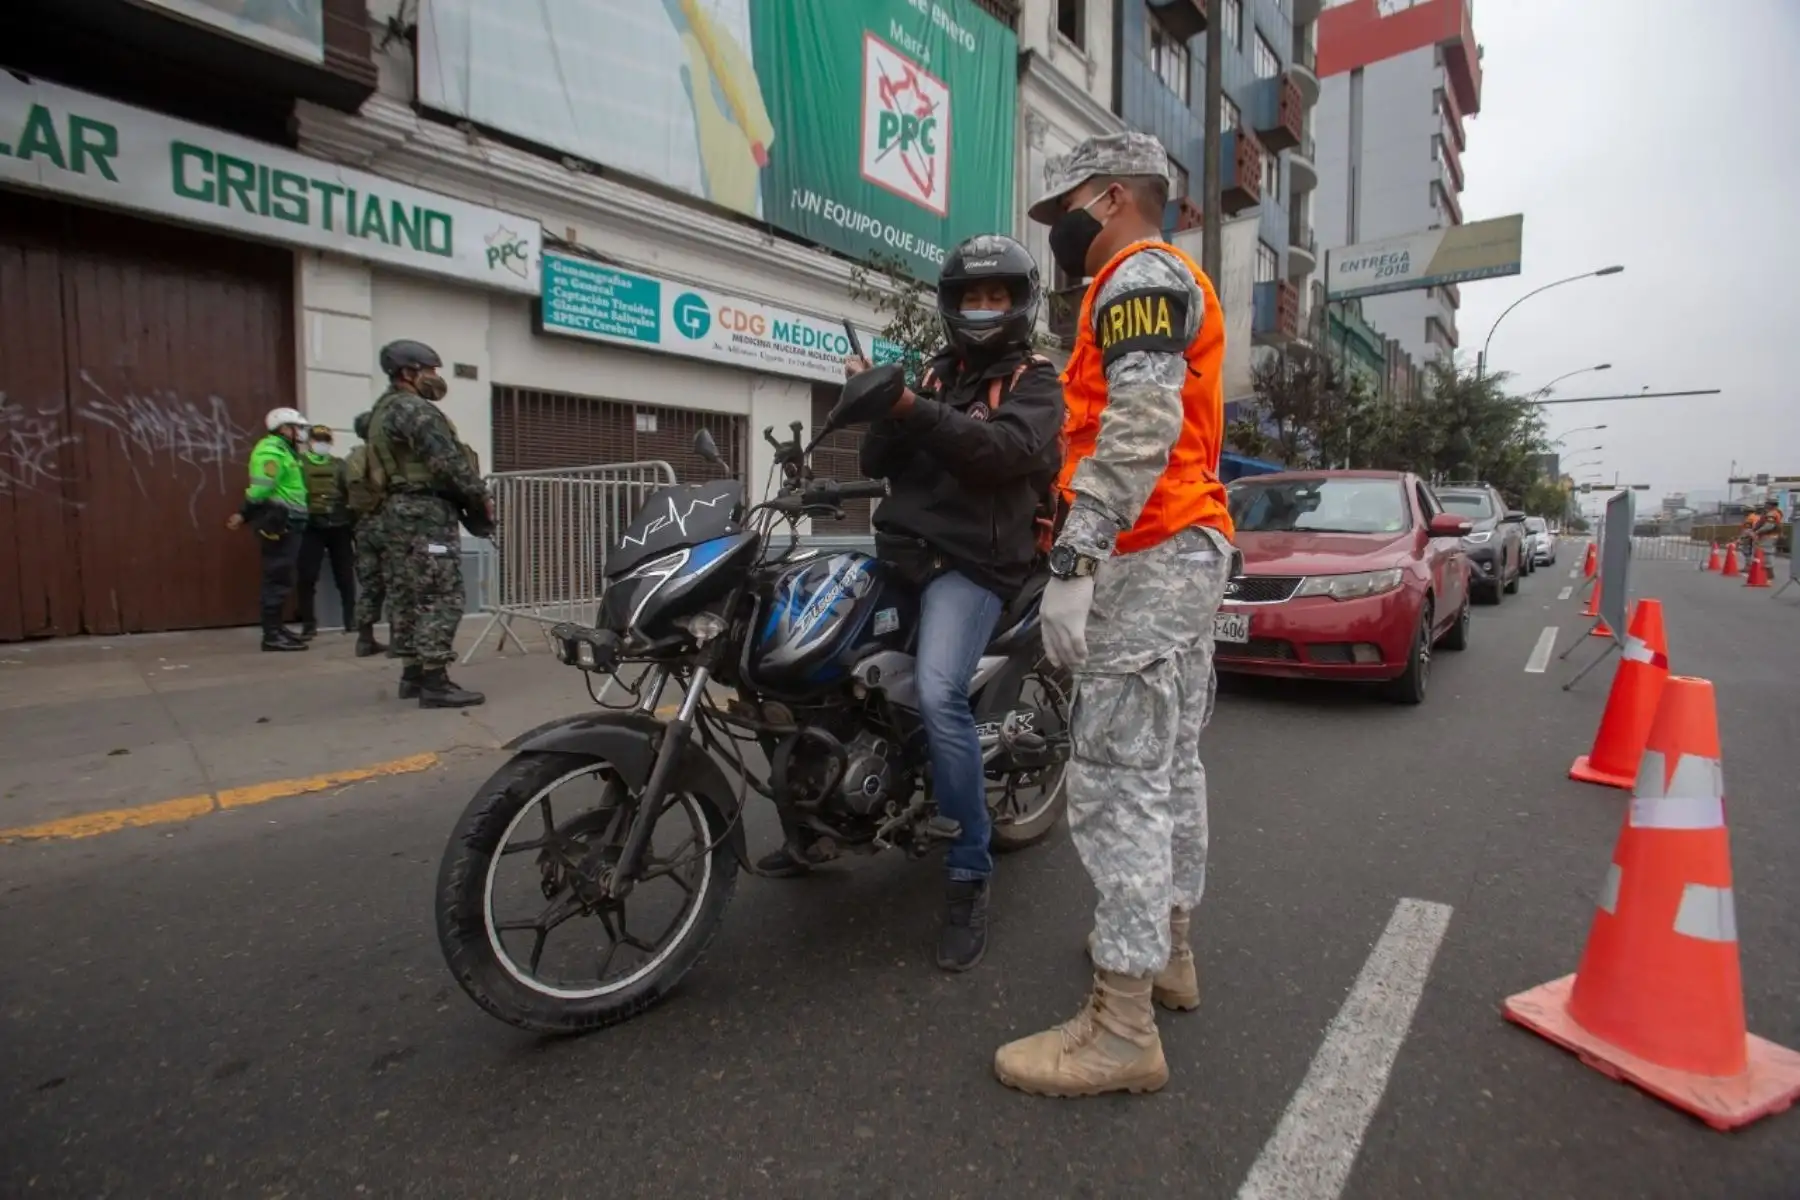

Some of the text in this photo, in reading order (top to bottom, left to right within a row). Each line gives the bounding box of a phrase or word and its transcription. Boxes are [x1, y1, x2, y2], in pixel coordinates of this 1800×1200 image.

[931, 3, 976, 53] enero
[877, 109, 937, 156] PPC
[0, 102, 454, 258] AR CRISTIANO
[823, 199, 882, 239] EQUIPO
[884, 225, 914, 251] QUE
[913, 239, 946, 265] JUEG
[486, 240, 529, 270] PPC
[1339, 250, 1410, 274] ENTREGA
[1375, 262, 1410, 279] 2018
[592, 319, 638, 337] Cerebral
[718, 307, 766, 337] CDG
[732, 333, 771, 349] MEDICINA
[773, 342, 806, 356] NUCLEAR
[1213, 620, 1245, 638] -406
